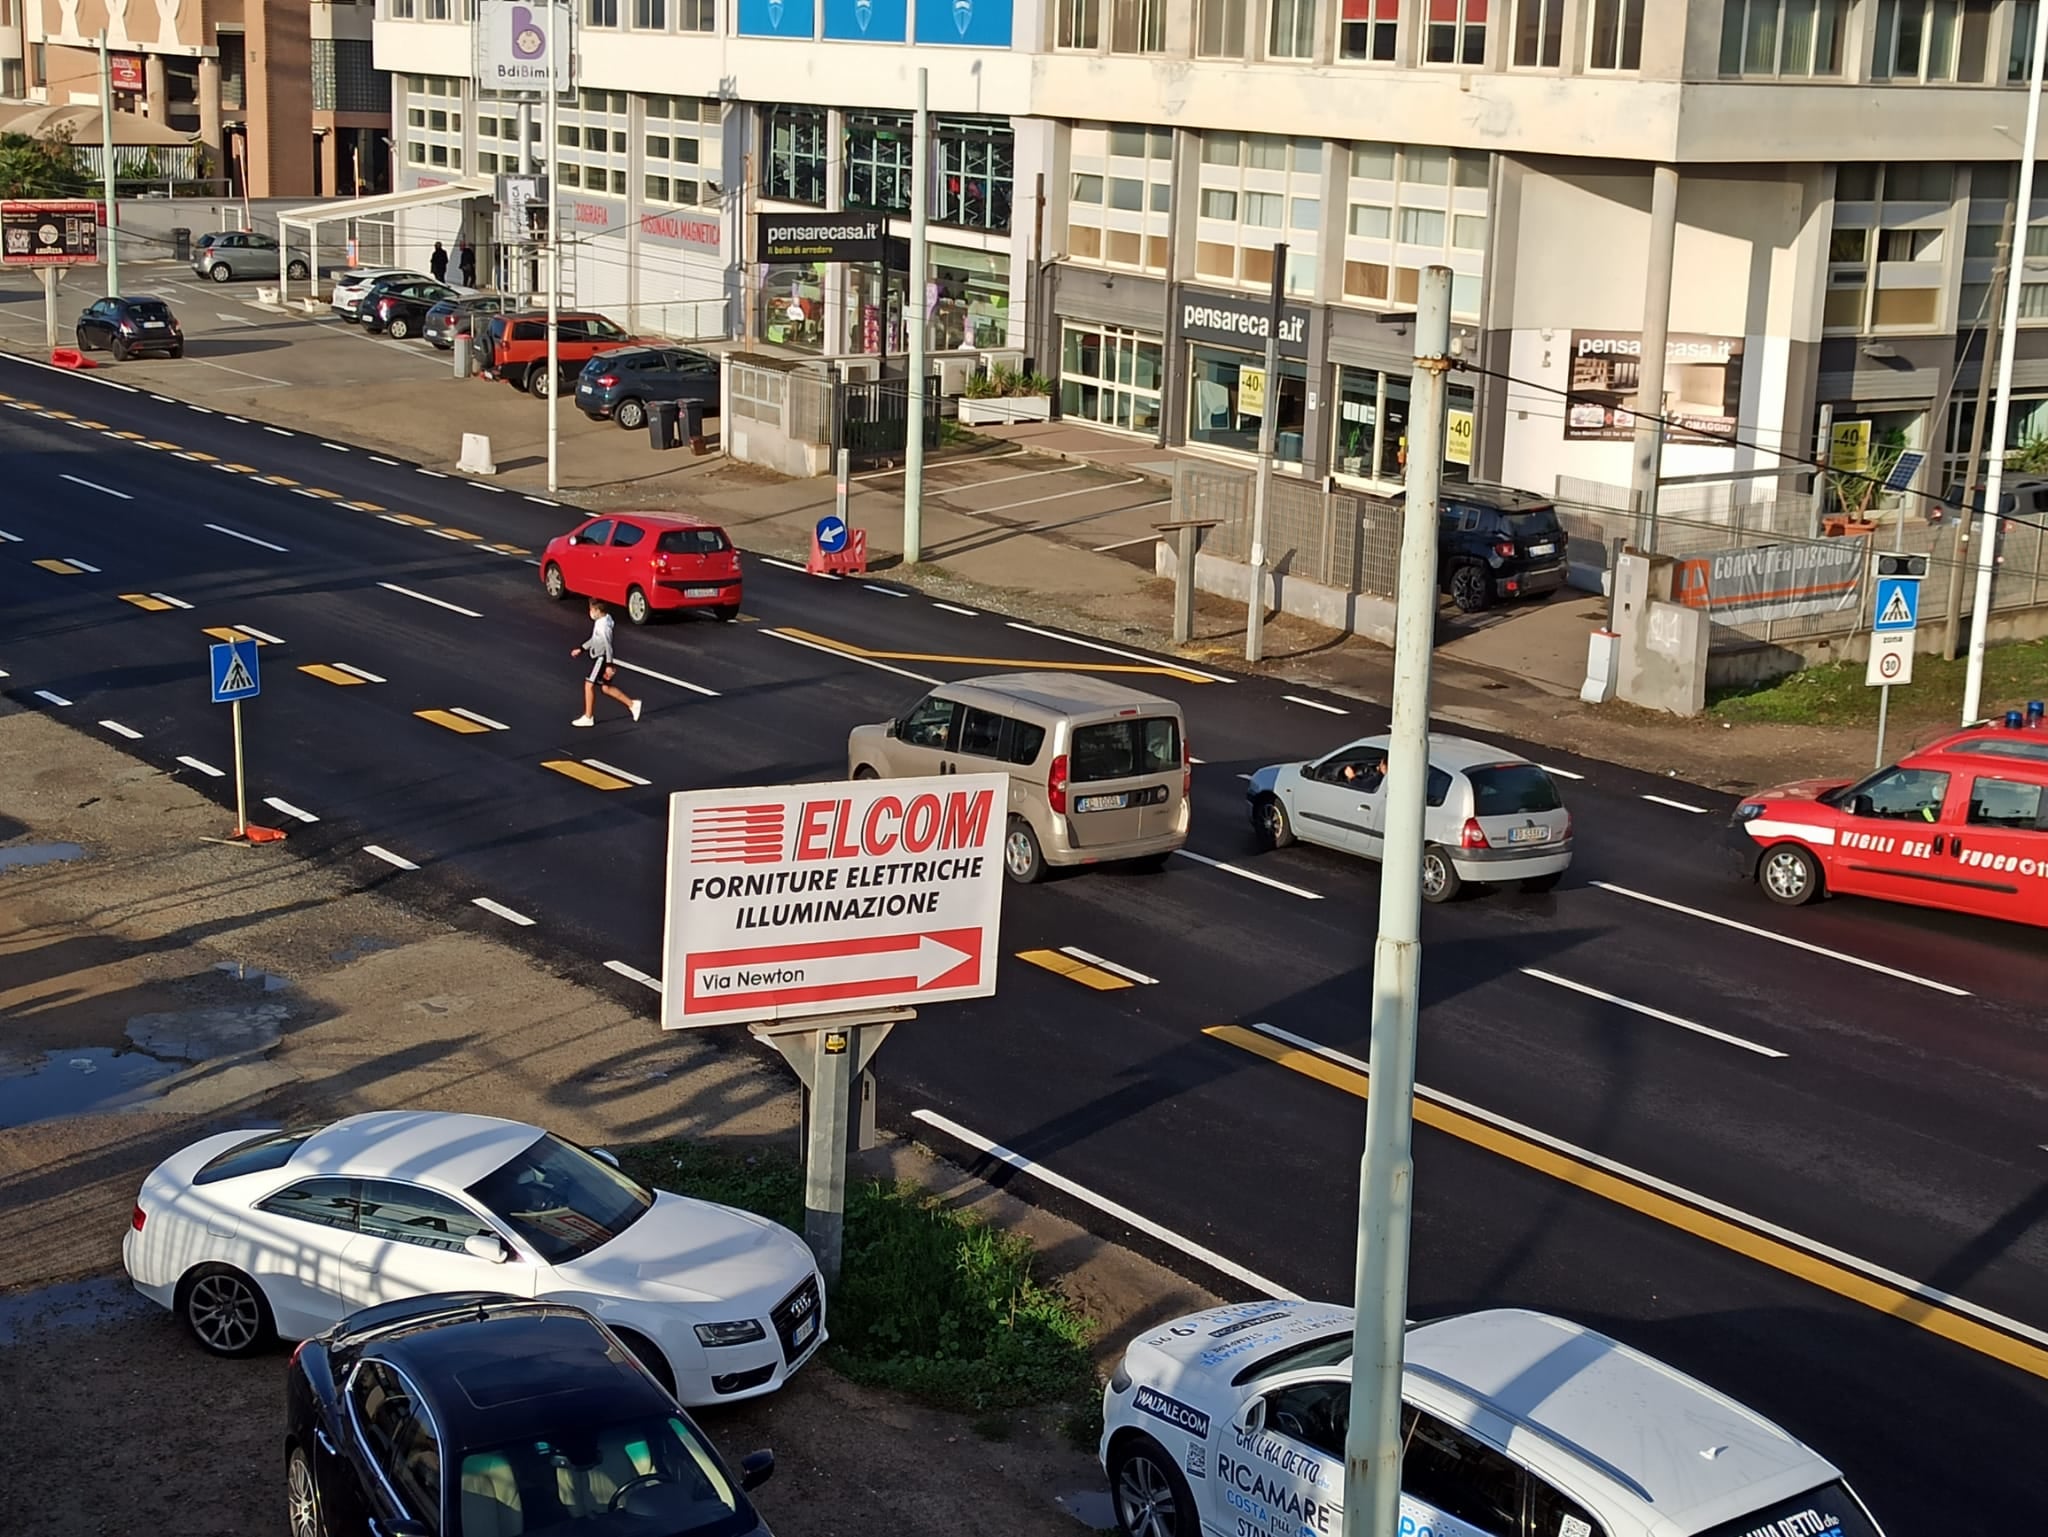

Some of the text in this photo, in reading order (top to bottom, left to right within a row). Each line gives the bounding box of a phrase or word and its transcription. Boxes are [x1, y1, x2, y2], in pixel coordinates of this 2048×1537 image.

[498, 65, 558, 78] BdiBimi
[681, 219, 720, 245] MAGNETICA
[767, 222, 877, 244] pensarecasa.it
[1183, 304, 1302, 342] pensarecaa.it
[1578, 337, 1731, 360] pensacasa.it
[1715, 550, 1791, 580] COMPUTER
[1885, 660, 1896, 671] 30
[793, 790, 994, 861] ELCOM
[1841, 831, 1895, 853] VIGILI
[1901, 840, 1932, 859] DEL
[1959, 850, 2018, 871] FUOCO
[690, 857, 983, 900] FORNITURE ELETTRICHE
[736, 892, 939, 929] ILLUMINAZIONE
[703, 968, 804, 990] Via Newton
[1137, 1390, 1206, 1434] WALTALE.COM
[1281, 1449, 1320, 1483] DETTO
[1218, 1453, 1330, 1534] RICAMARE
[1226, 1489, 1268, 1521] COSTA
[1270, 1515, 1291, 1534] più
